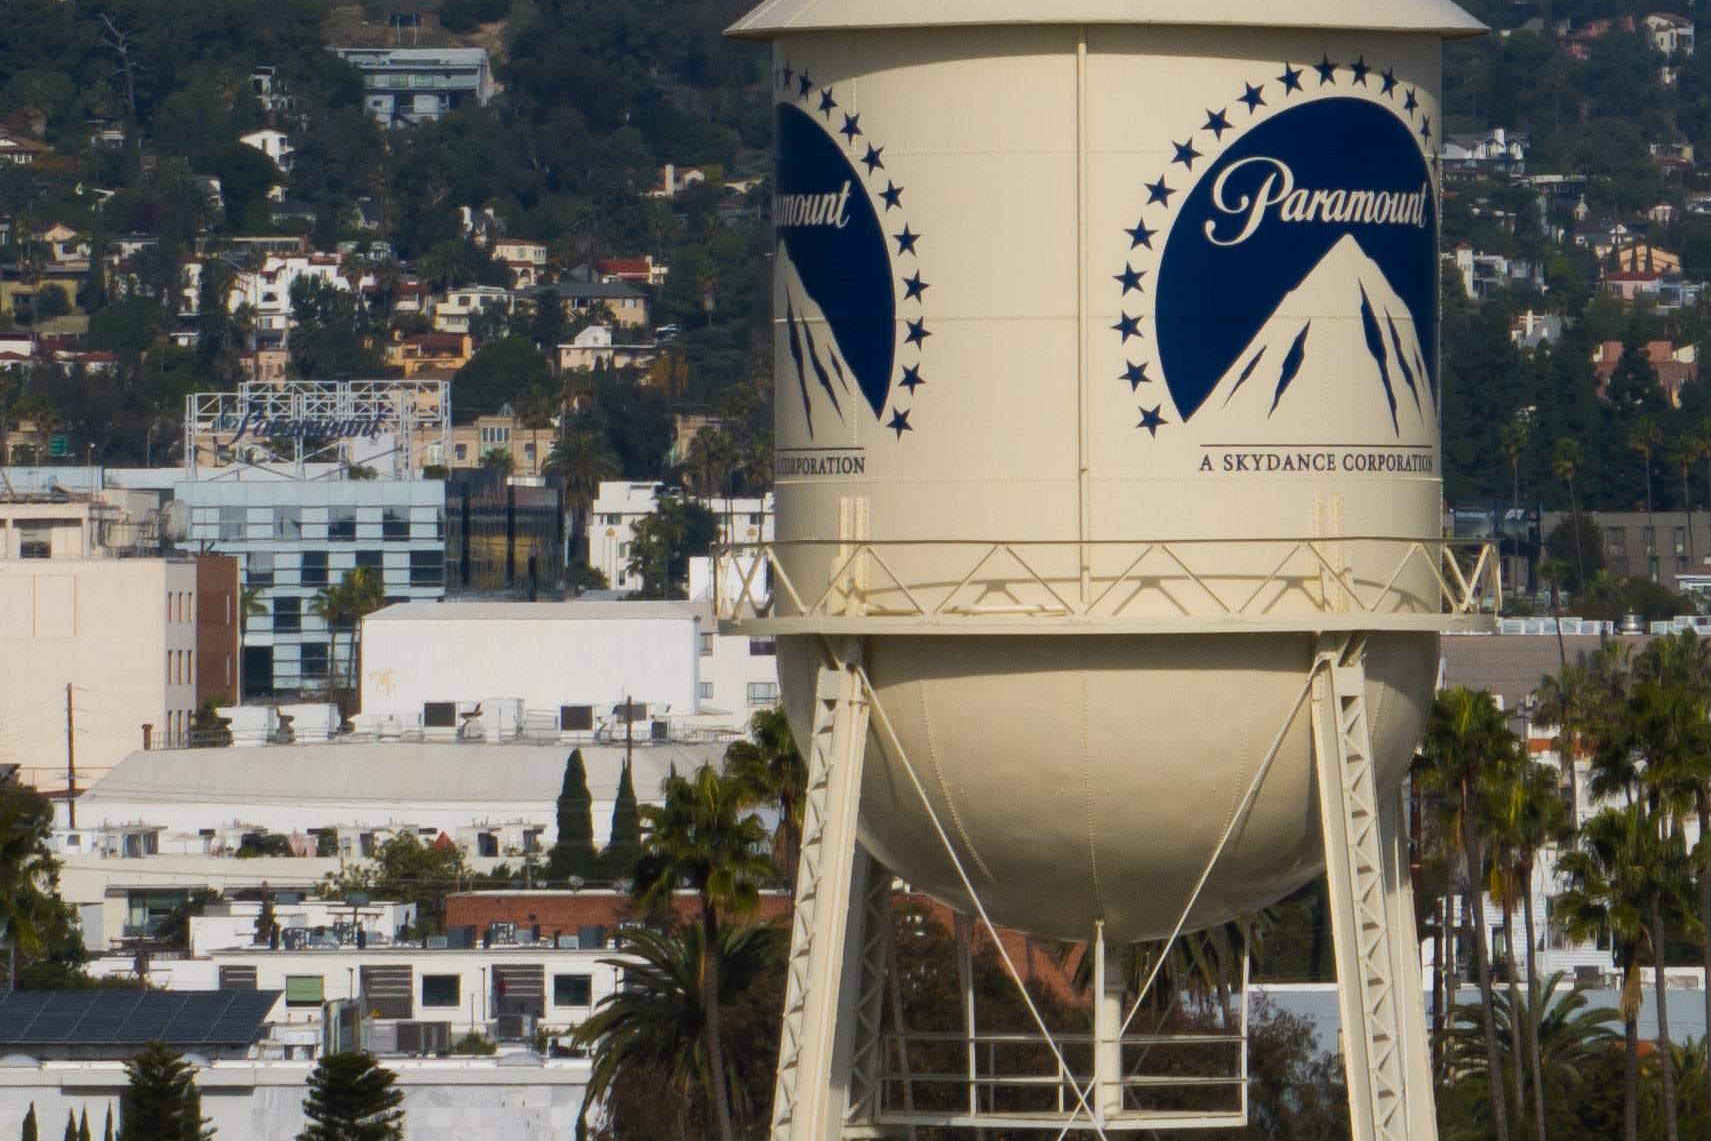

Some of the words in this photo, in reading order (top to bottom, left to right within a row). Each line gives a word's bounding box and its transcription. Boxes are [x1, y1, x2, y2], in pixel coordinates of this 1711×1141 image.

[1204, 156, 1428, 246] Paramount
[1198, 454, 1215, 472] A
[1223, 453, 1337, 472] SKYDANCE
[1343, 454, 1433, 473] CORPORATION
